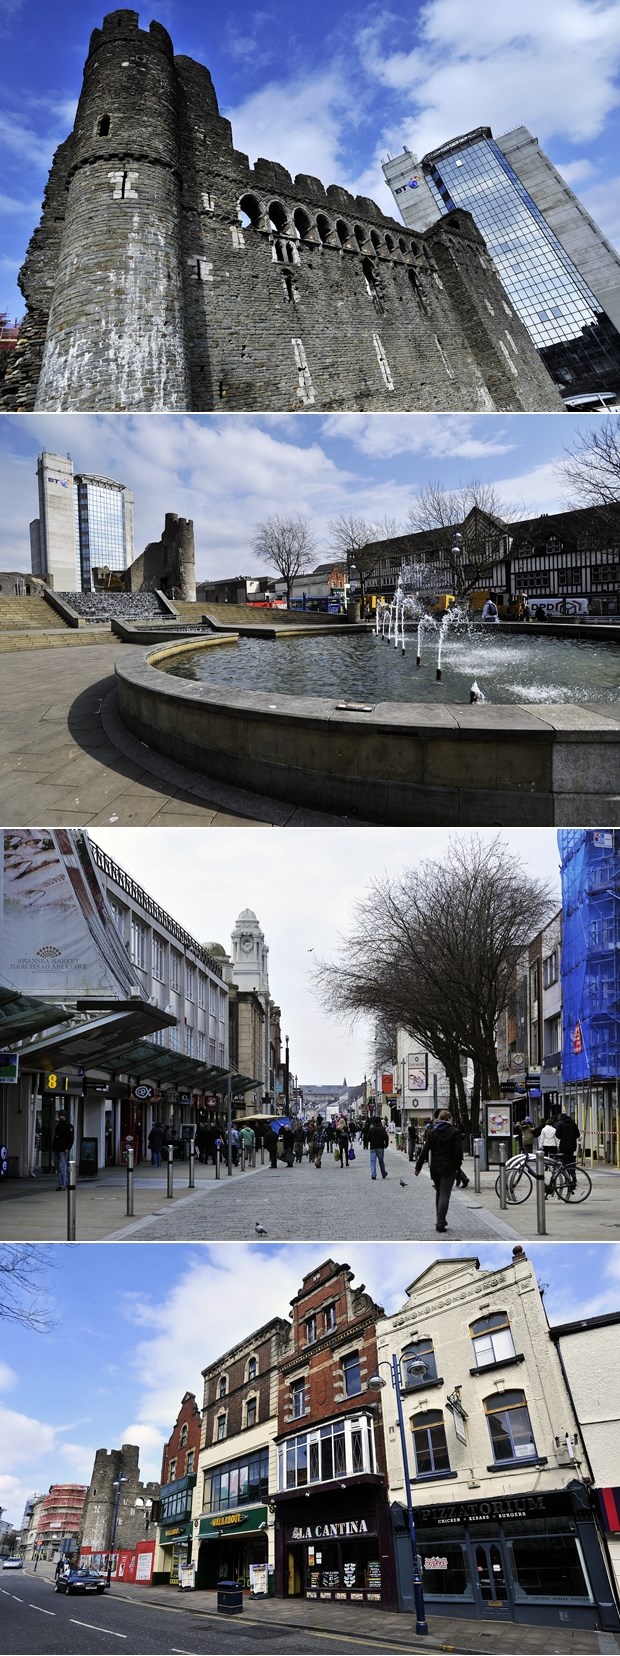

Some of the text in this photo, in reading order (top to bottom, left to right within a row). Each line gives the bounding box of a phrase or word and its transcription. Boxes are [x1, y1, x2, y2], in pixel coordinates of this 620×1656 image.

[394, 185, 407, 194] BT
[531, 603, 555, 611] DPD
[420, 1497, 546, 1520] PIZZATORIUM
[211, 1513, 241, 1527] WALKABOUT
[498, 1511, 527, 1519] BURGERS
[314, 1519, 368, 1537] CANTINA
